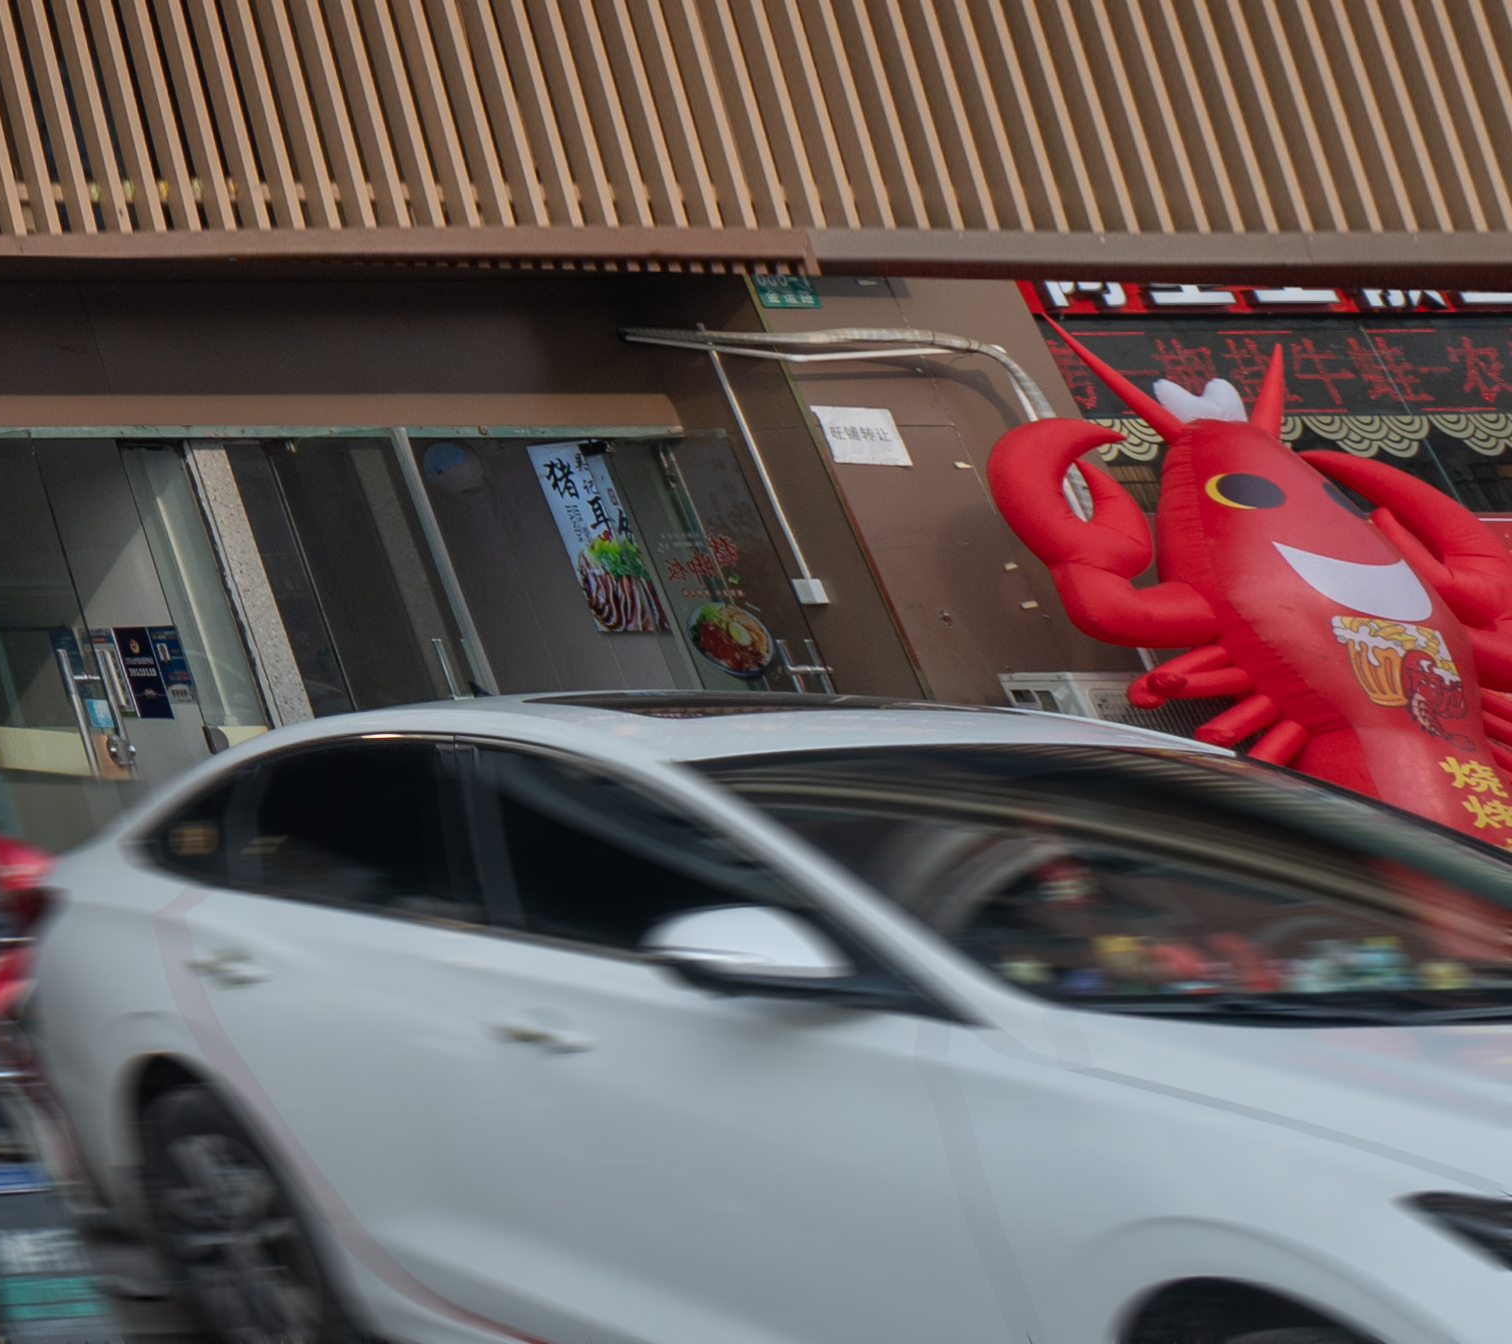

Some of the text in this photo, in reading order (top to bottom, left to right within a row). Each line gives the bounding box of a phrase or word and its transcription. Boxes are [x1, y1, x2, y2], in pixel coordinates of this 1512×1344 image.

[829, 424, 894, 443] 旺铺转让
[1438, 756, 1512, 846] 烧烤
